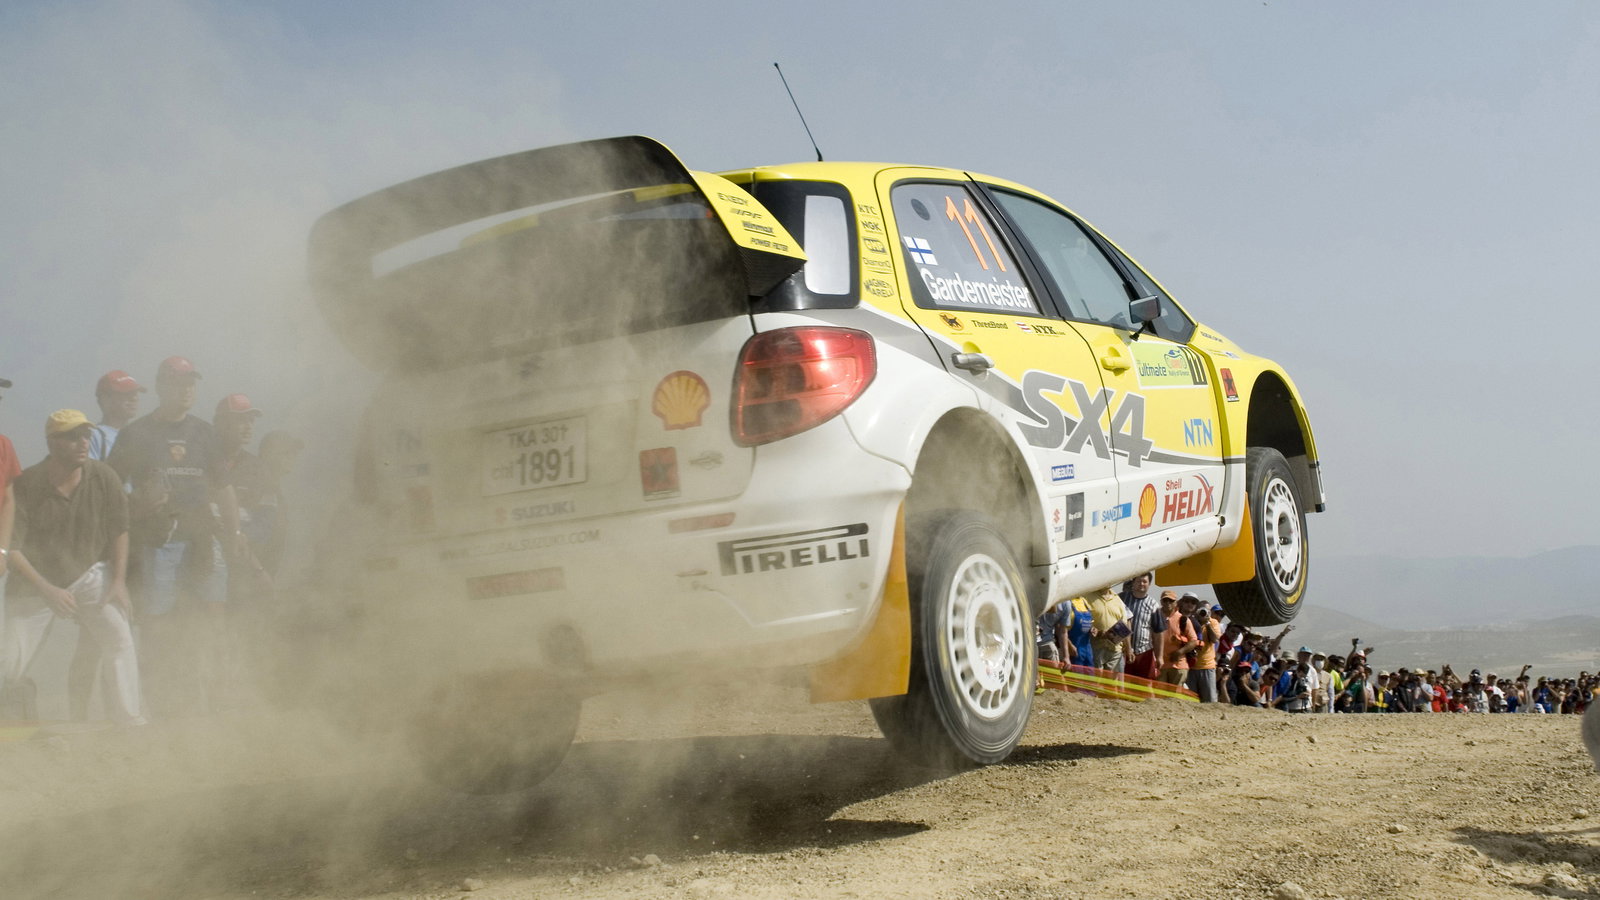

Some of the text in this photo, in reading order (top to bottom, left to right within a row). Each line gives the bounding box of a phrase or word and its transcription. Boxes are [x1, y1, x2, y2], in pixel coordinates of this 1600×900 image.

[858, 204, 878, 215] KTC
[945, 196, 1006, 272] 11
[920, 267, 1033, 309] Gardemeister
[971, 320, 1009, 330] ThreeBond
[1017, 370, 1153, 467] SX4
[1183, 418, 1213, 448] NTN
[515, 445, 576, 486] 1891
[1165, 478, 1182, 491] Shell
[511, 501, 577, 520] SUZUKI
[1162, 475, 1214, 524] HELIX
[718, 523, 870, 576] PIRELLI
